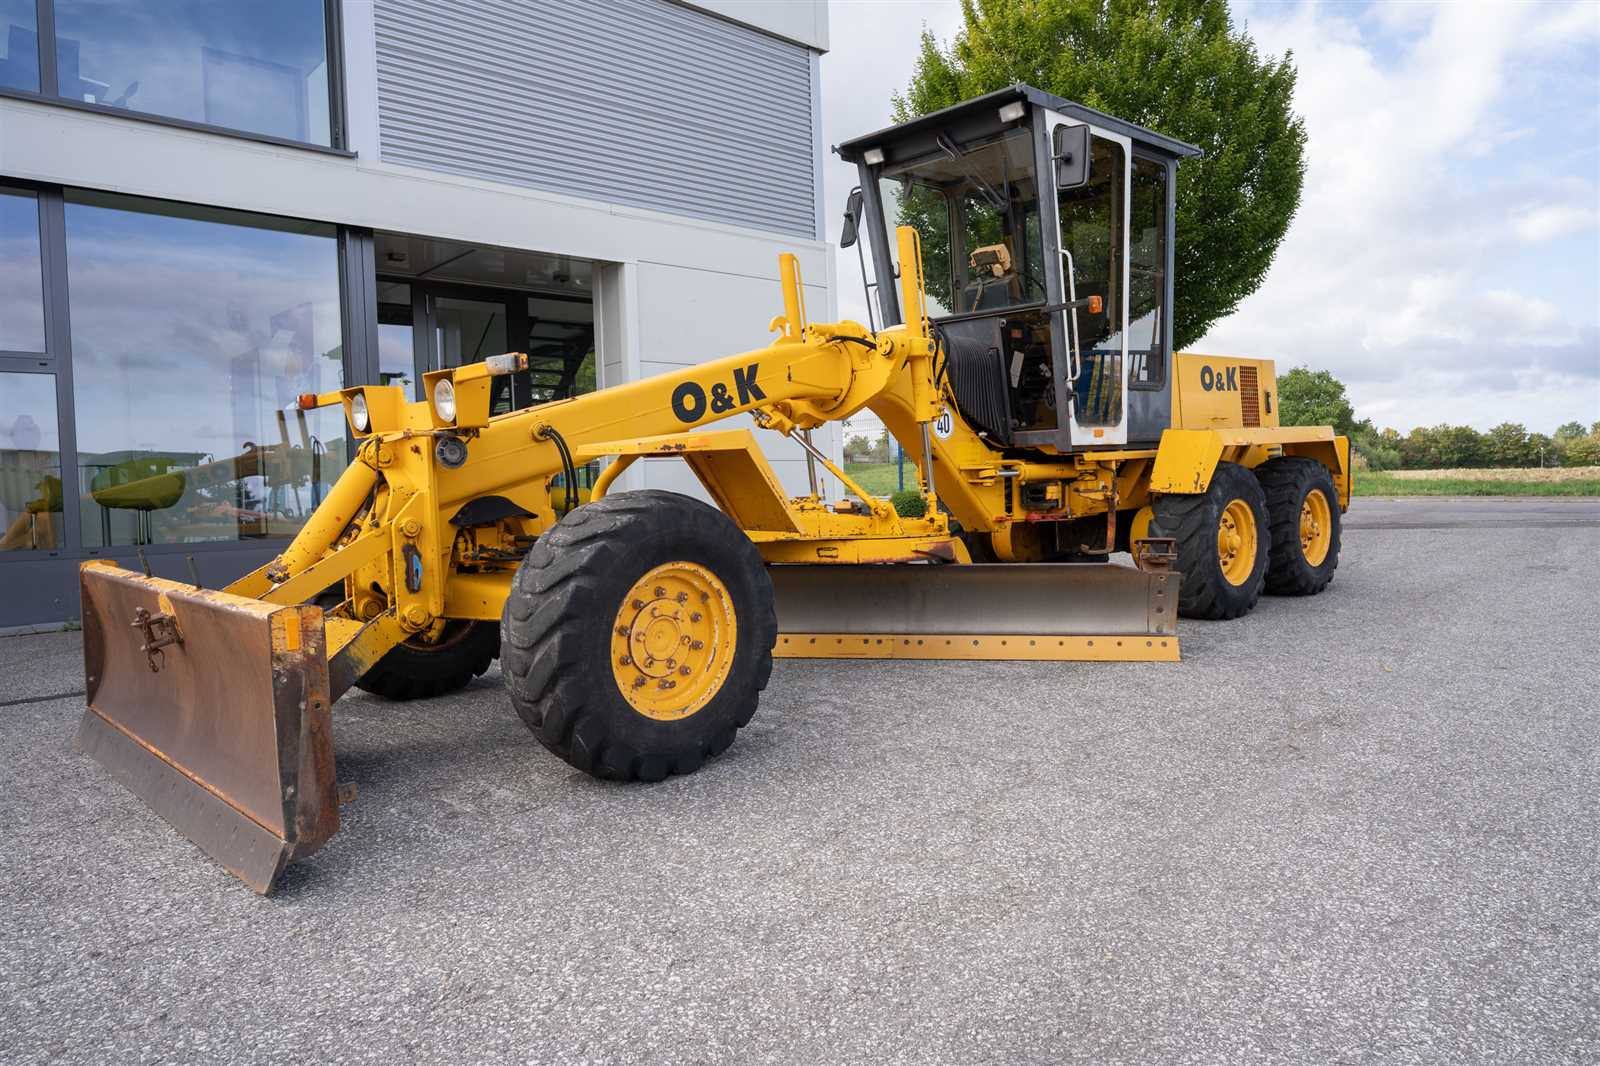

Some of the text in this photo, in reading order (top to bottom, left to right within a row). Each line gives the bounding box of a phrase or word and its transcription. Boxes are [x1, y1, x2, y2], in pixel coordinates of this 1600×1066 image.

[1200, 365, 1238, 391] O&K
[672, 363, 767, 423] O&K
[937, 413, 950, 433] 40
